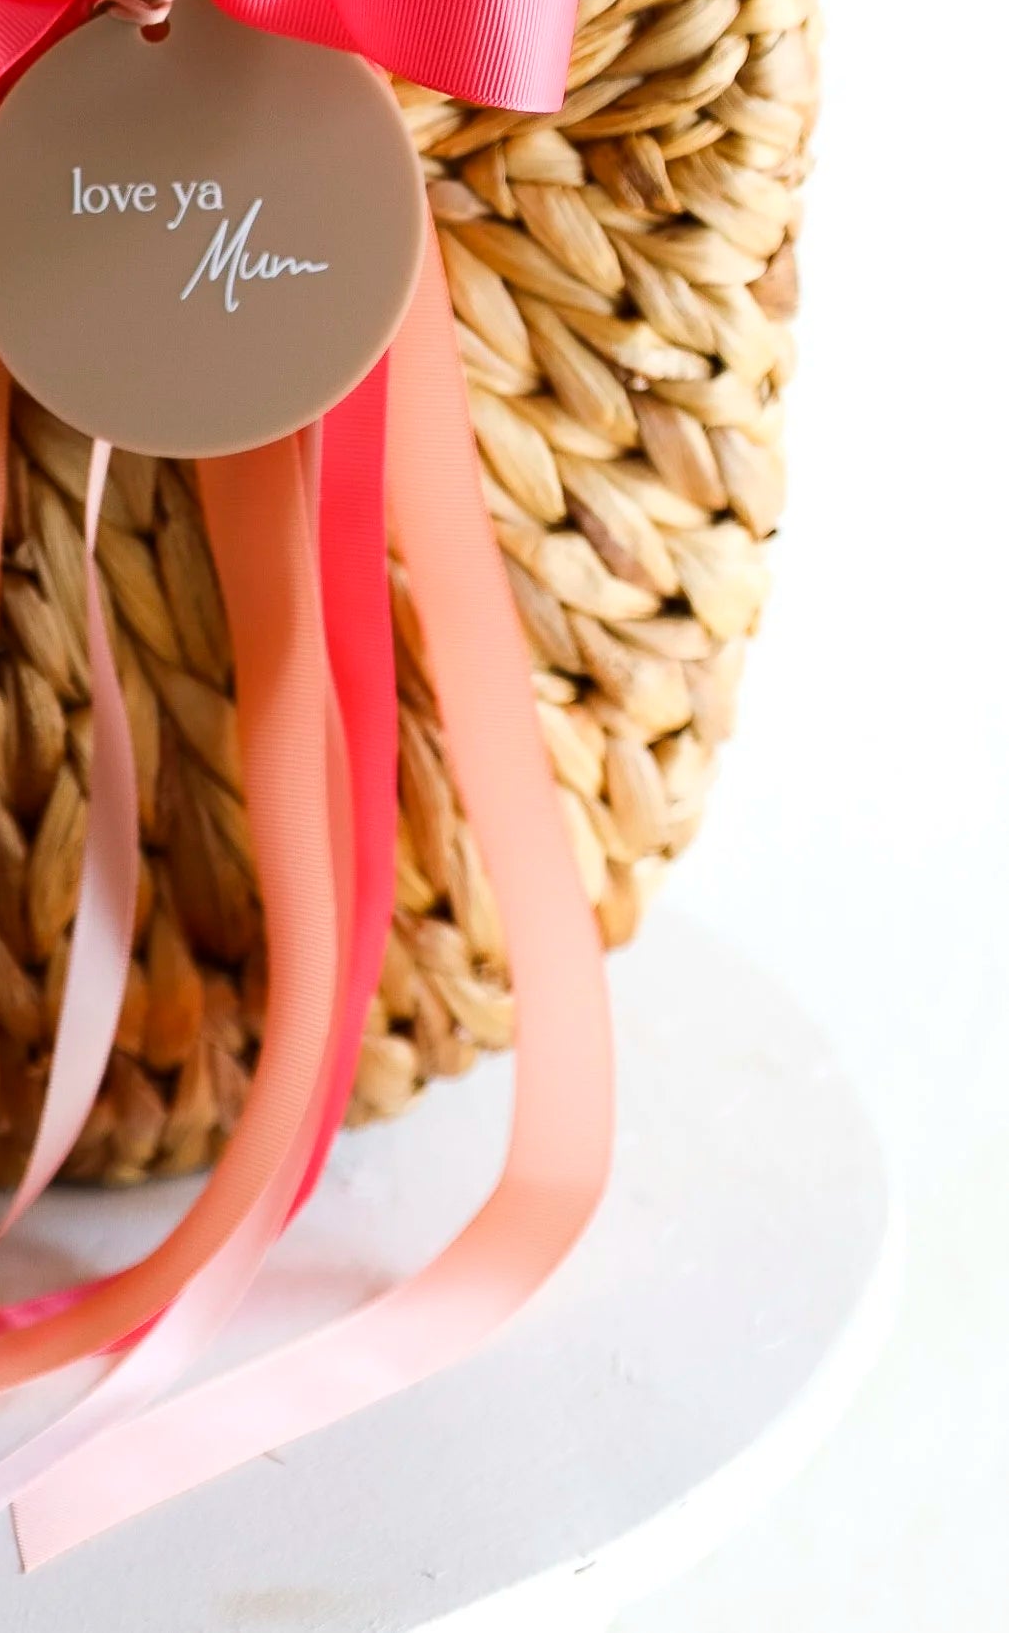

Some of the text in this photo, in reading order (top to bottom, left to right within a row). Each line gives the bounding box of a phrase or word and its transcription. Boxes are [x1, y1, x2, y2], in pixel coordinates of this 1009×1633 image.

[71, 166, 225, 231] love ya
[179, 197, 331, 314] Mum
